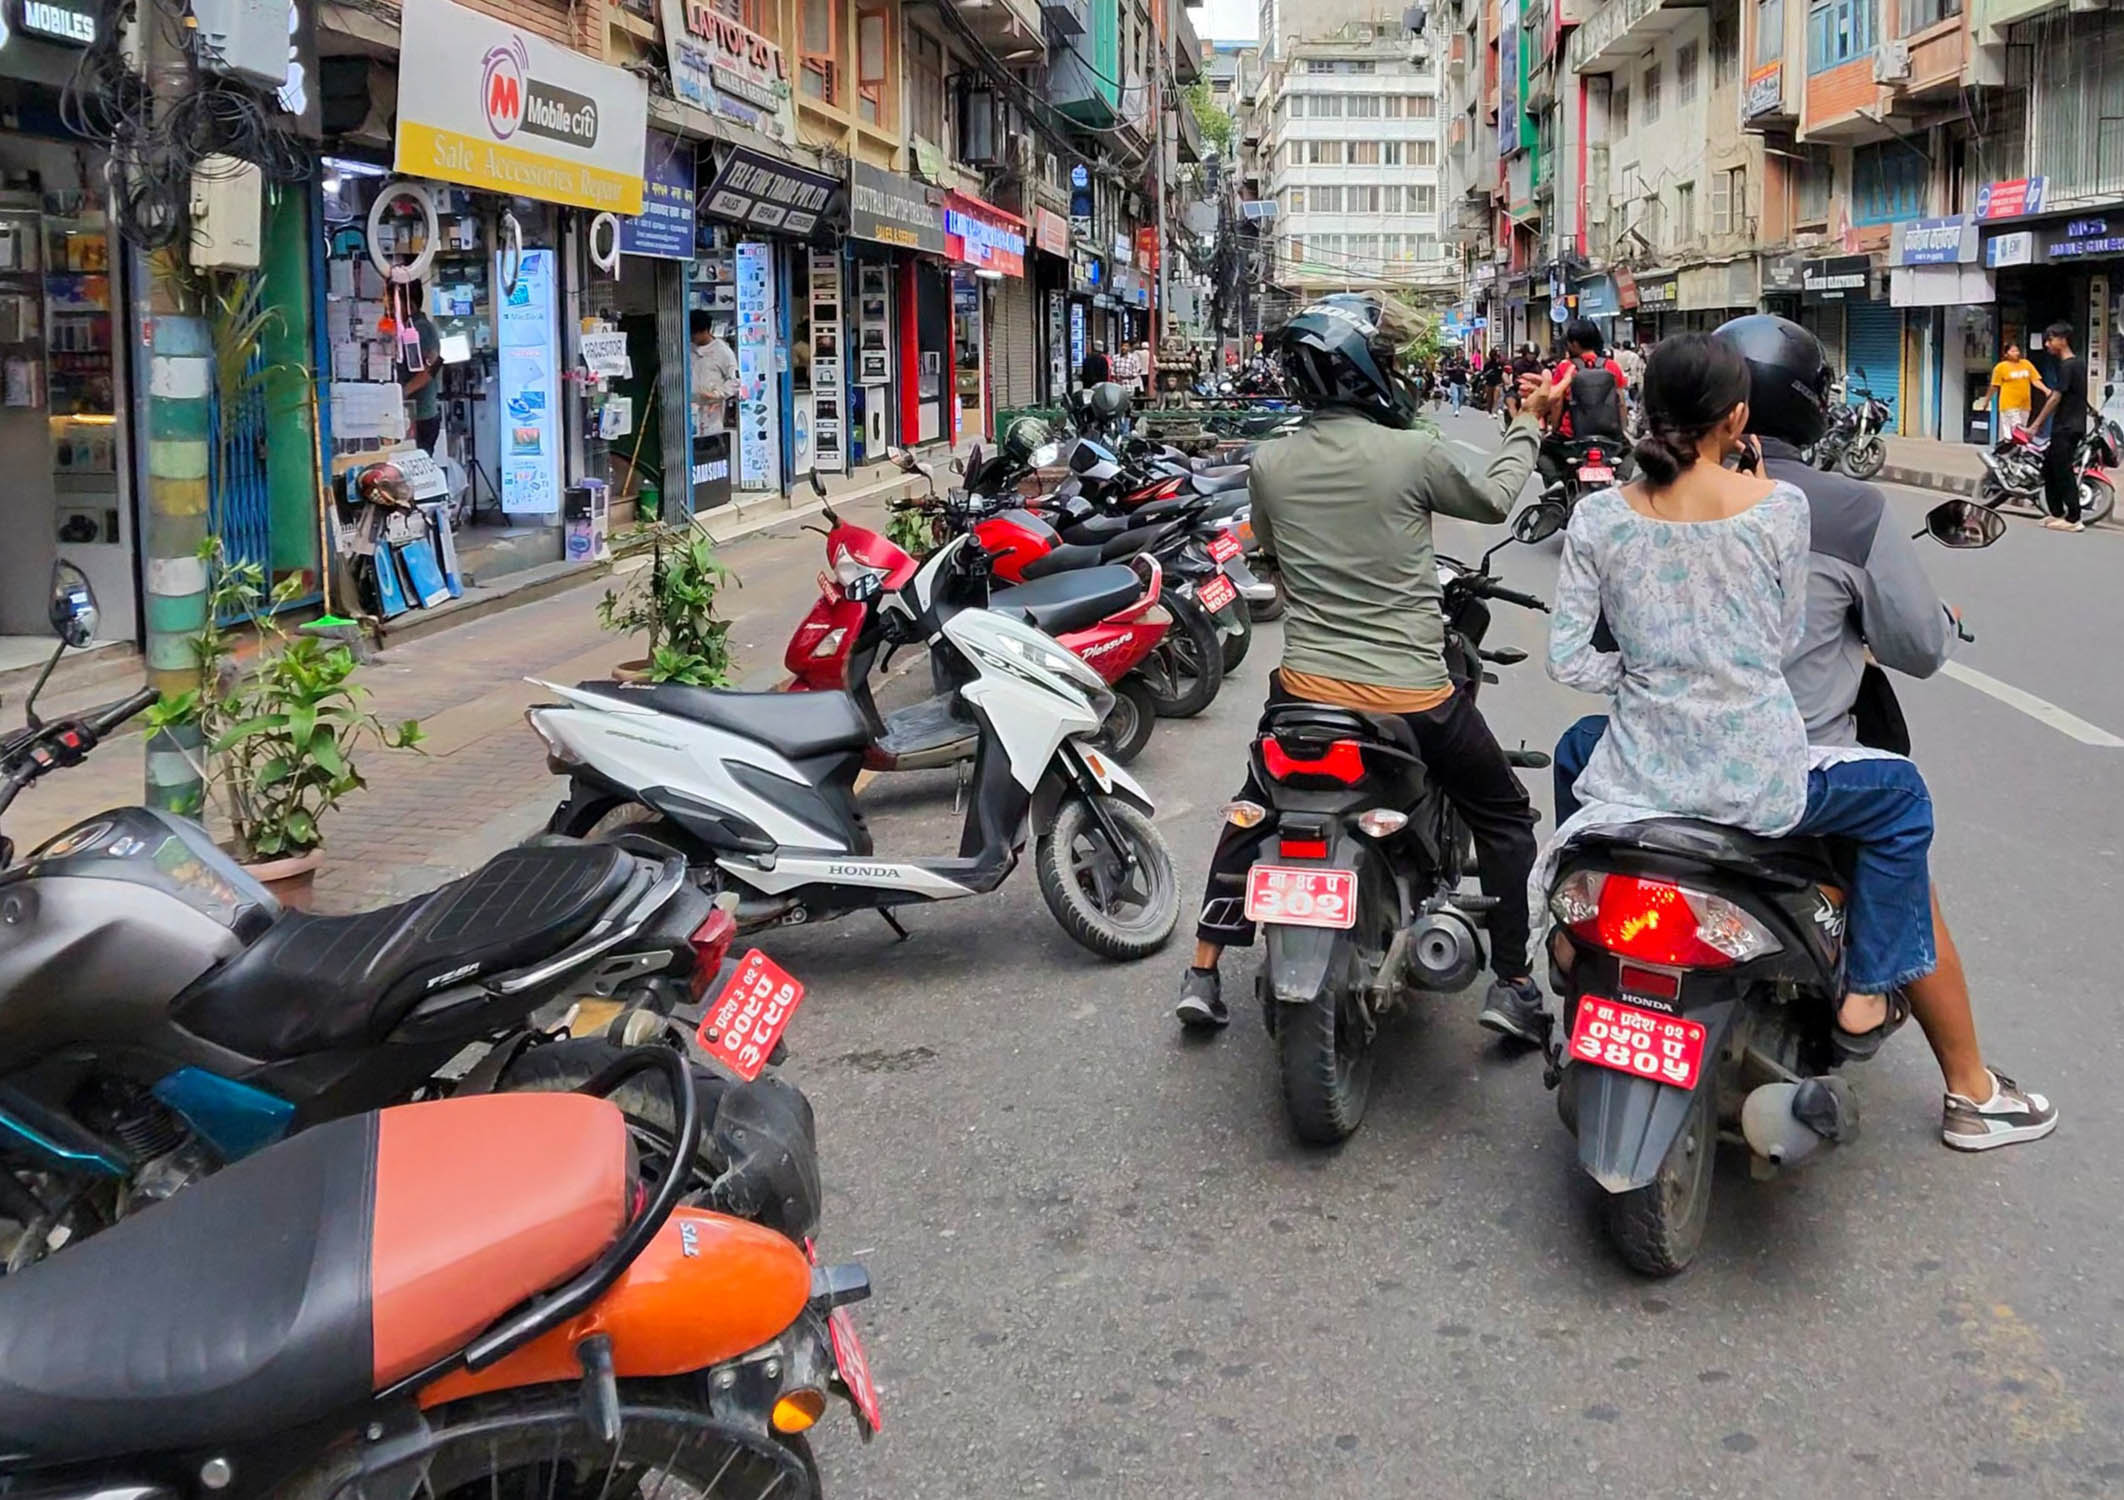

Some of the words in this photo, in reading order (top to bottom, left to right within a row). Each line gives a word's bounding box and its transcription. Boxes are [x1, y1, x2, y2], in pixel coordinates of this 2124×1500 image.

[25, 0, 96, 43] MOBILES
[686, 4, 746, 55] LAPTOP
[527, 93, 572, 134] Mobile
[433, 134, 475, 174] Sale
[483, 147, 575, 194] Accessories
[580, 168, 623, 205] Repair
[720, 195, 742, 211] SALES
[692, 459, 728, 485] SAMSUNG
[1081, 631, 1134, 660] Pleasure
[828, 865, 901, 878] HONDA
[1622, 993, 1674, 1012] HONDA
[1577, 1035, 1690, 1082] ३४०५
[1662, 1040, 1687, 1059] प
[680, 1222, 700, 1257] TVS
